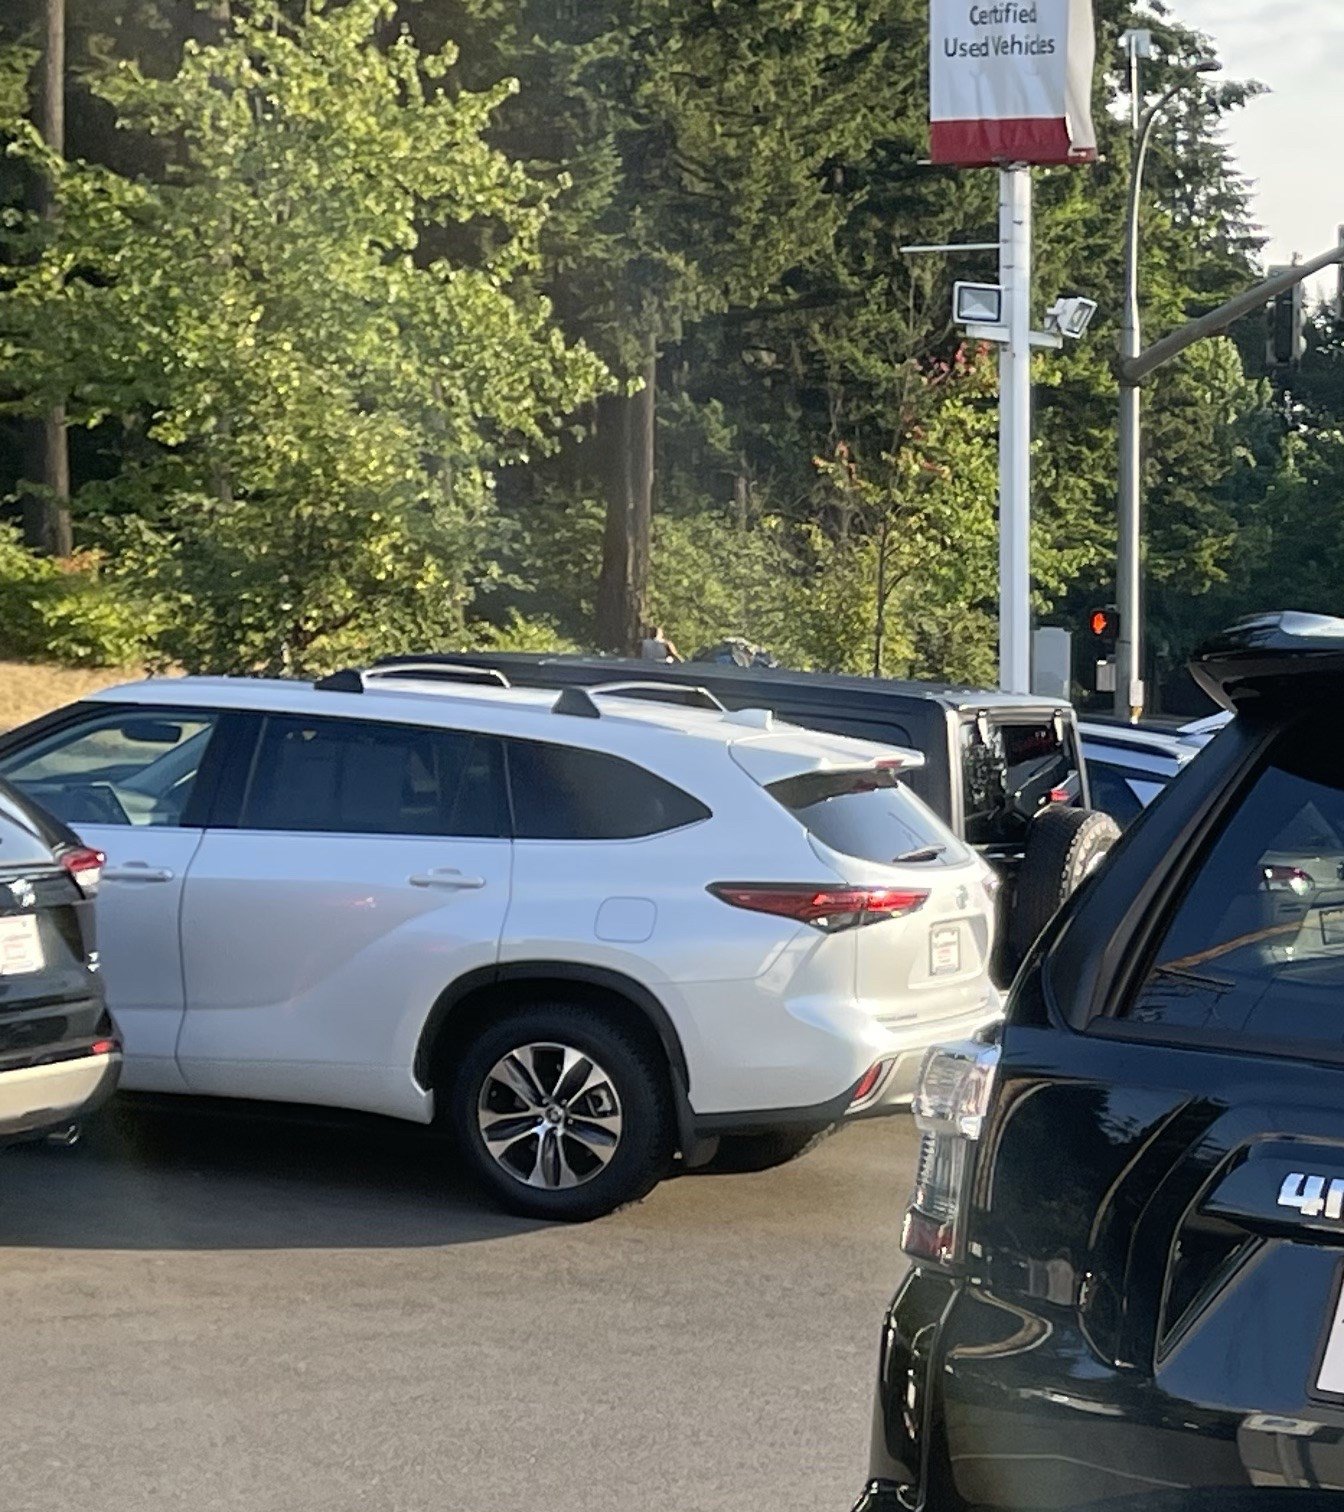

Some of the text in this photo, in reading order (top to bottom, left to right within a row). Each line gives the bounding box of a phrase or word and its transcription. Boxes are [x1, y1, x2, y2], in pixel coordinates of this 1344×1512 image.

[969, 2, 1037, 26] Certified
[944, 33, 1056, 58] Used Vehicles
